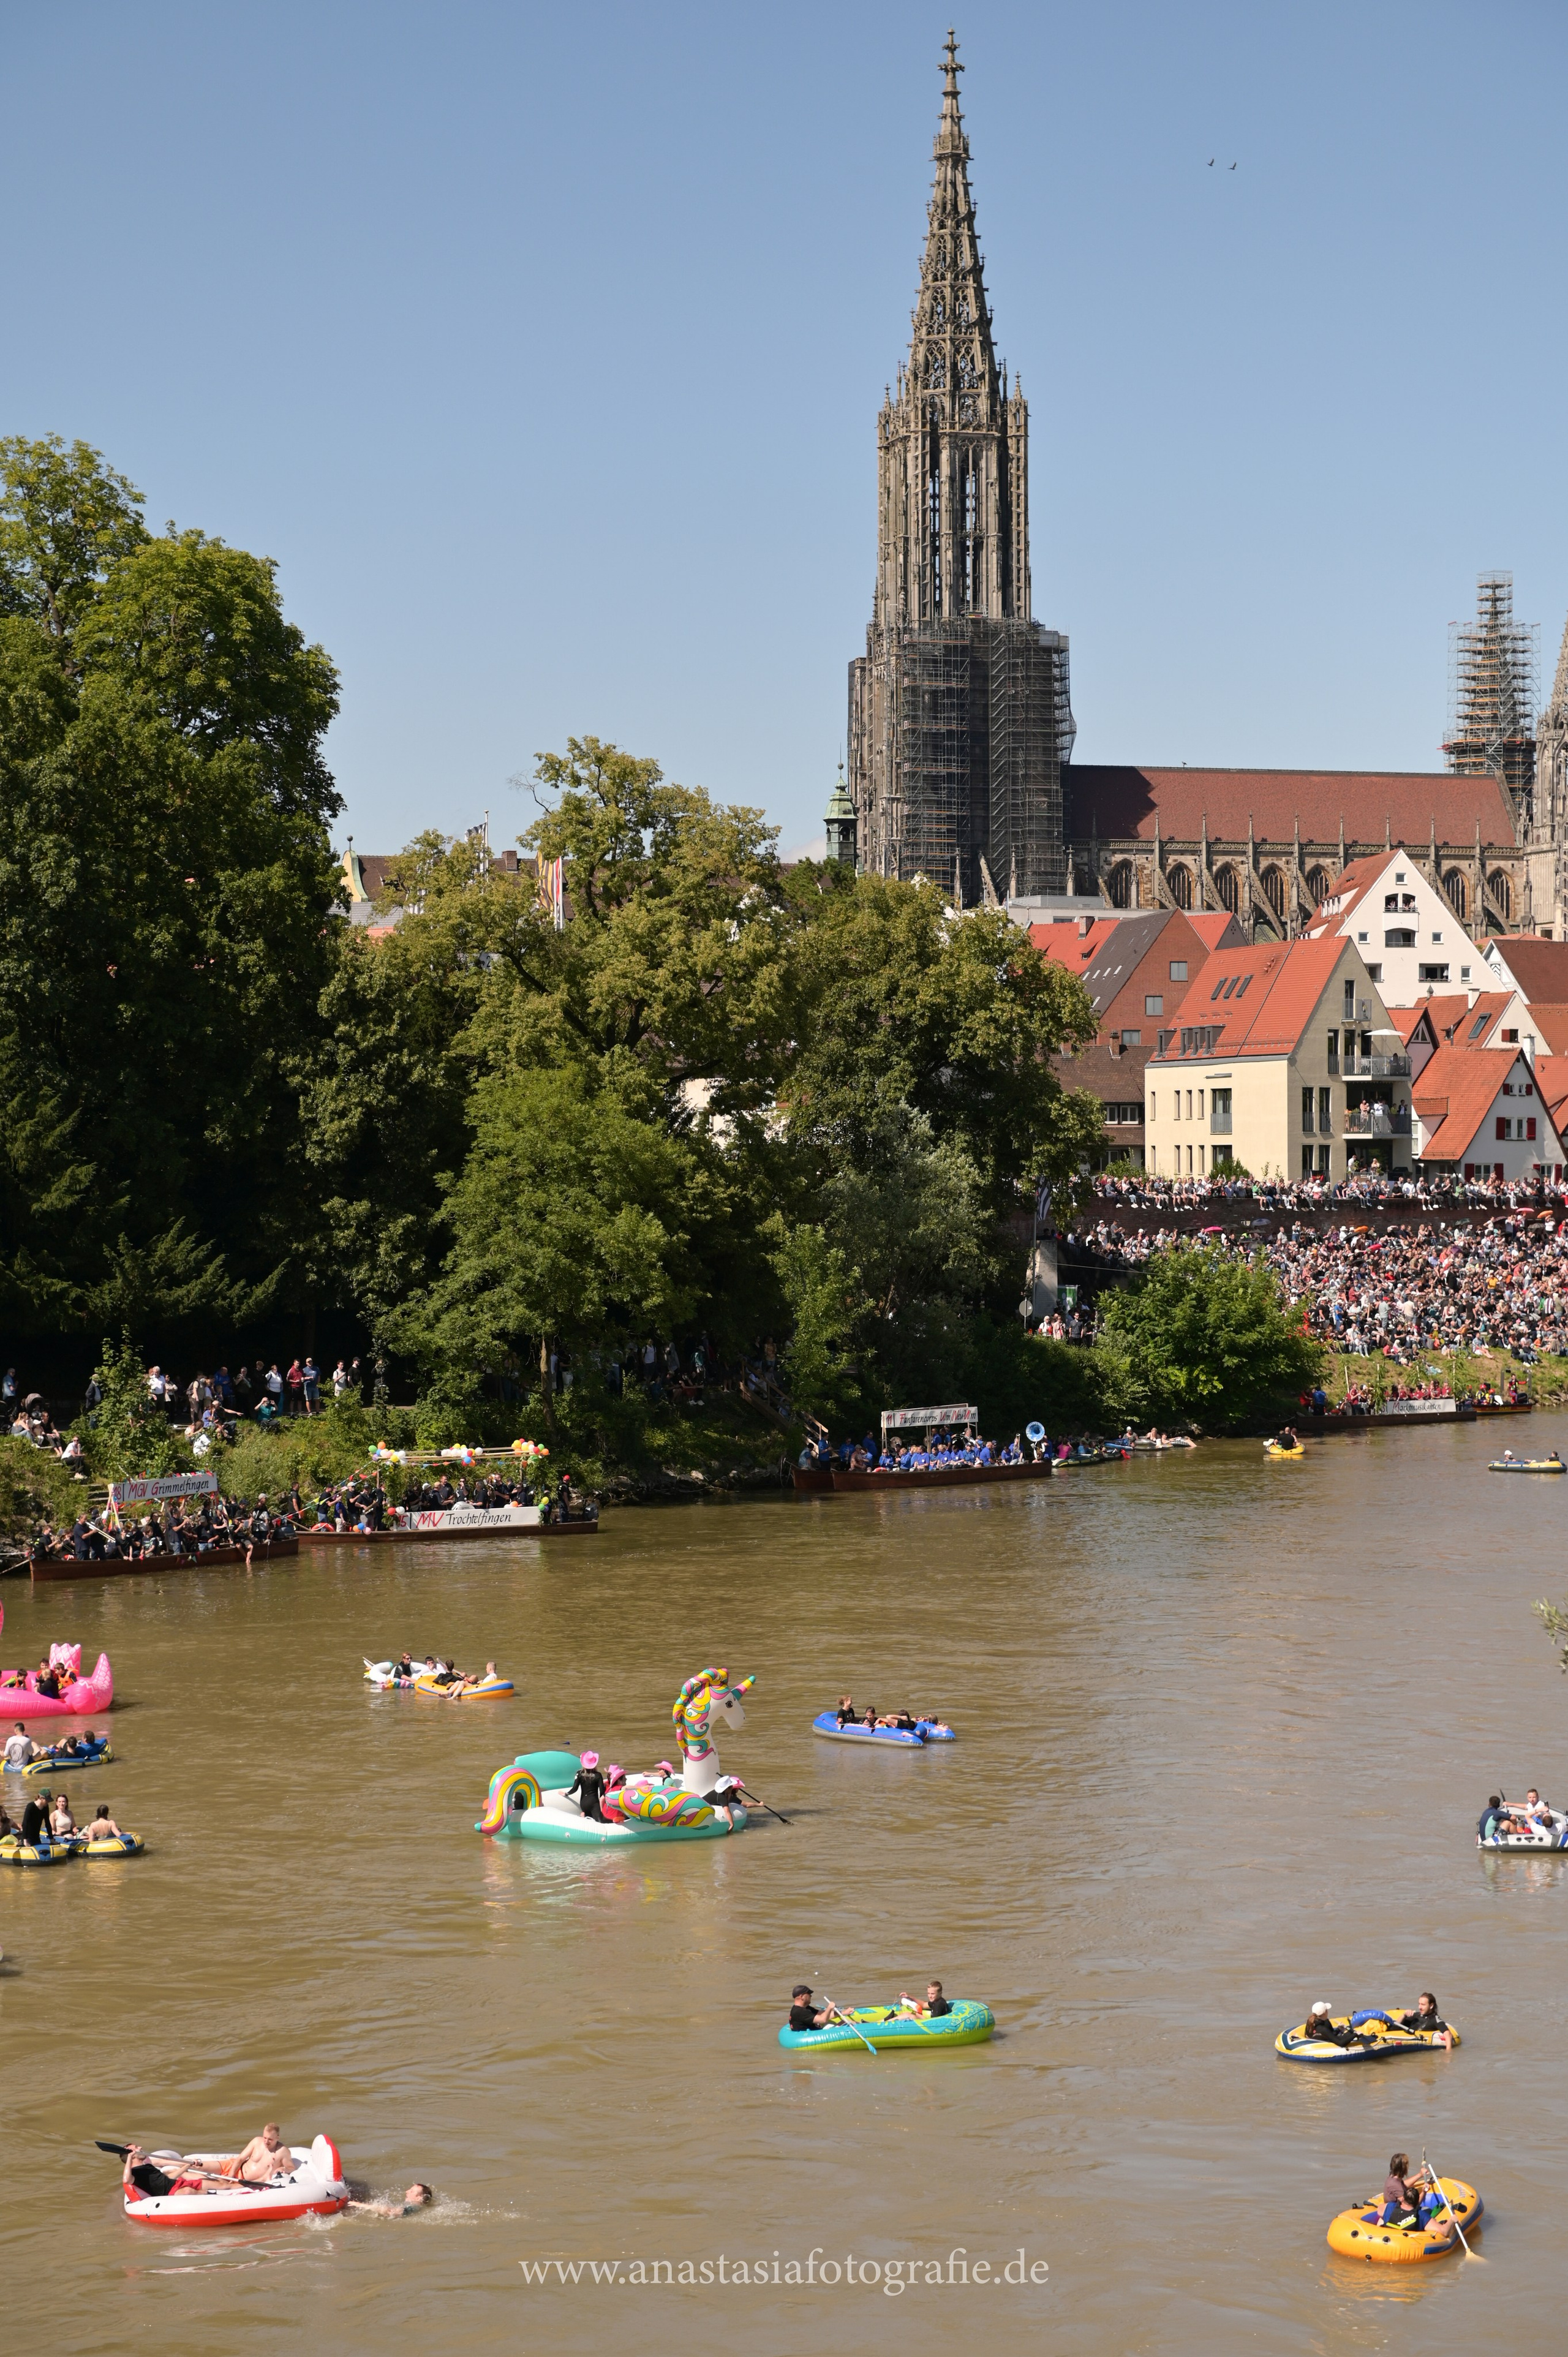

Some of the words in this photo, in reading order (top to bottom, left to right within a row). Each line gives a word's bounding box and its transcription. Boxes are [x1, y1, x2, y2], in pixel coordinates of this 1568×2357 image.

[1392, 1401, 1441, 1412] Marktmusikanten
[900, 1412, 938, 1426] Fanfarencorps
[128, 1482, 148, 1499] MGV
[151, 1477, 209, 1496] Grimmelfingen
[416, 1512, 444, 1528] MV
[445, 1511, 512, 1527] Trochtelfingen
